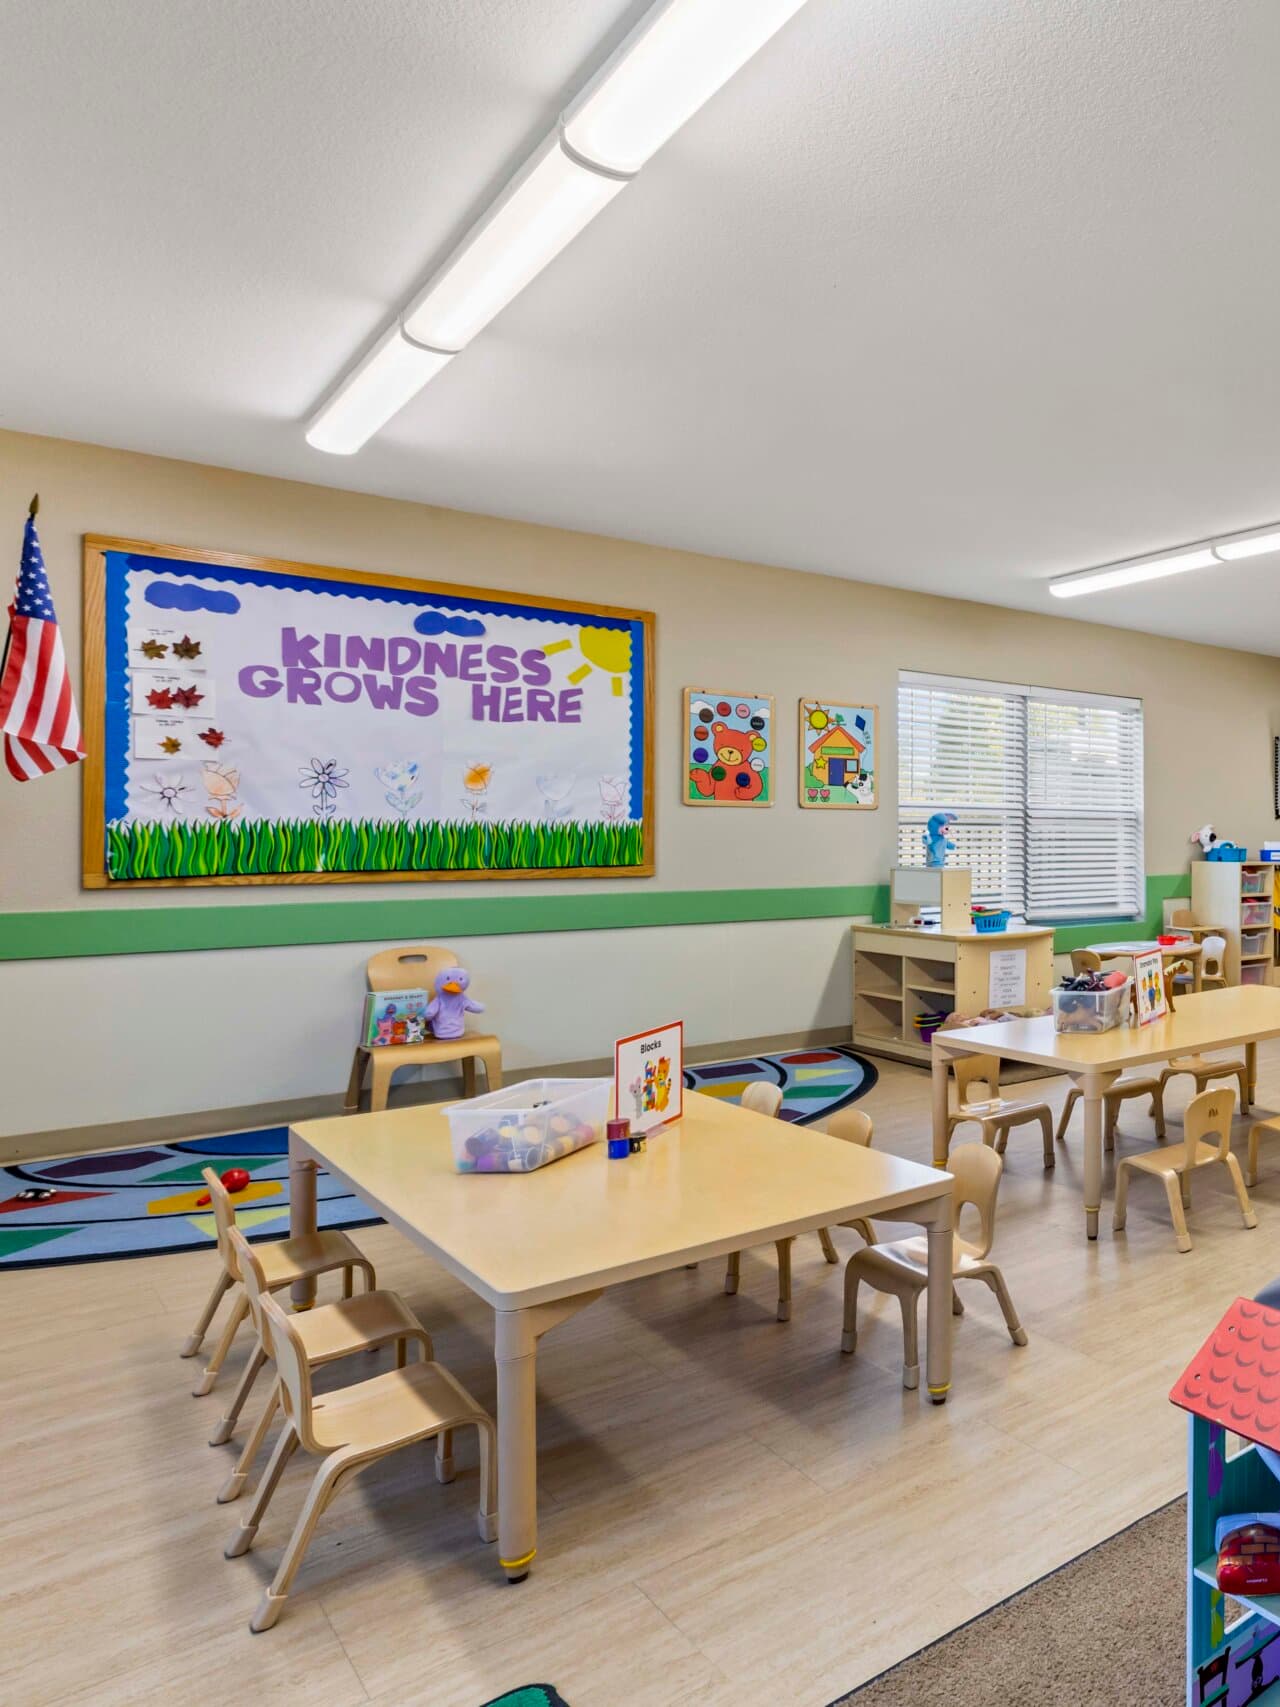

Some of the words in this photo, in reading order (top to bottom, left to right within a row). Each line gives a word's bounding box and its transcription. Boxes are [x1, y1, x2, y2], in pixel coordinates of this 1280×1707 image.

[281, 627, 551, 686] KINDNESS
[238, 665, 439, 716] GROWS
[472, 684, 583, 723] HERE
[640, 1040, 662, 1054] Blocks
